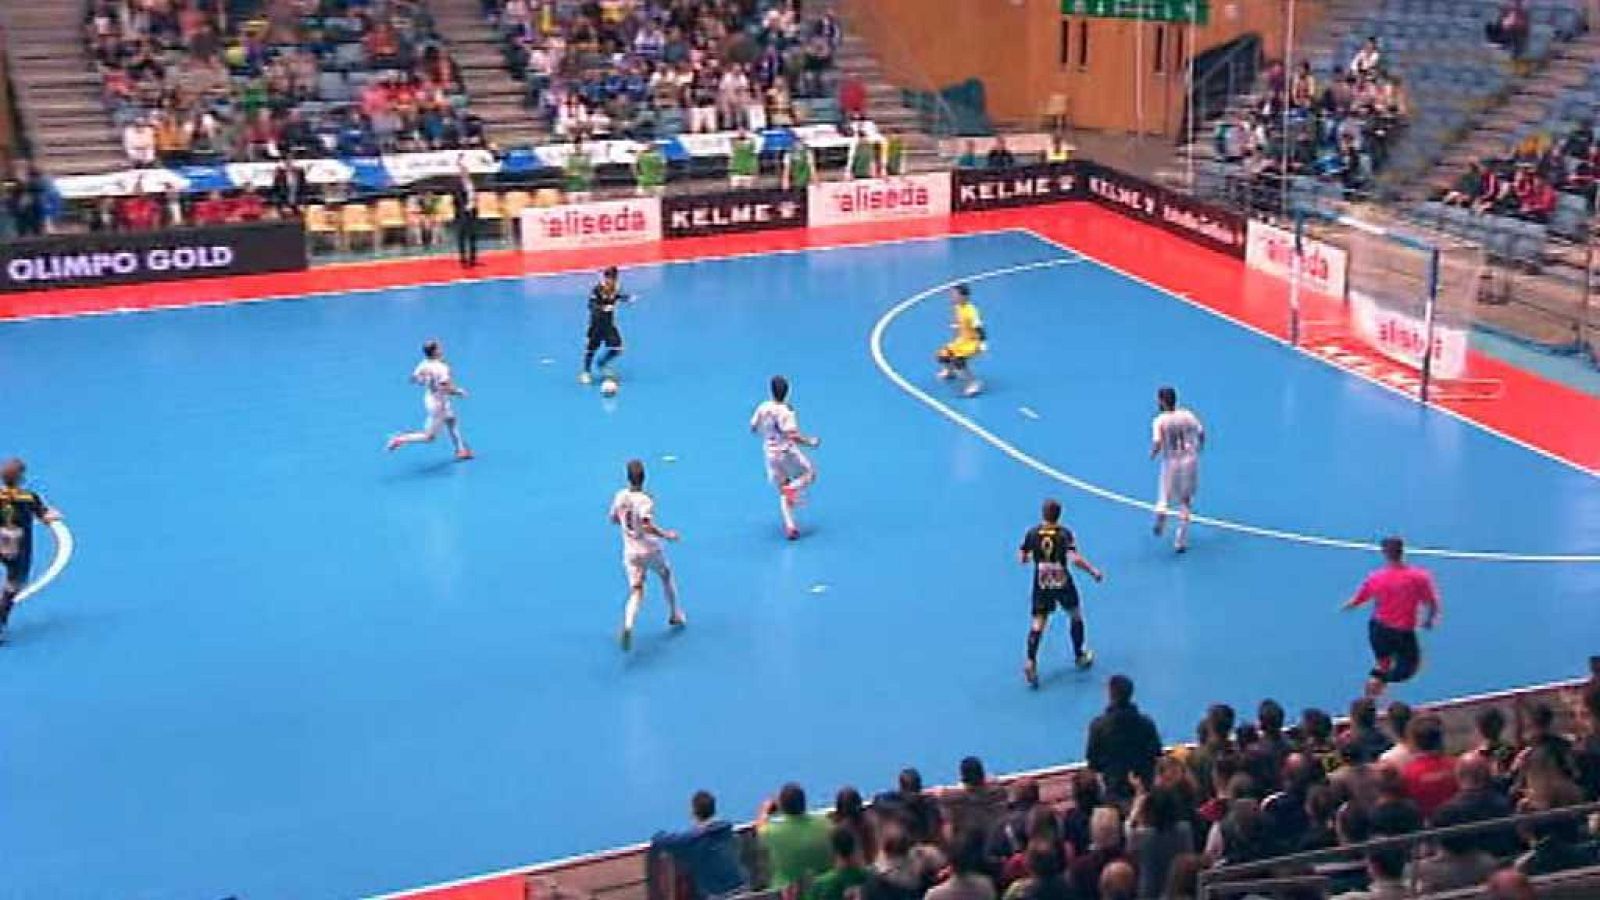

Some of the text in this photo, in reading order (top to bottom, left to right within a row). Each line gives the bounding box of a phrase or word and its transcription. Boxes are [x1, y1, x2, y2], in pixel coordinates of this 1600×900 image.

[839, 184, 929, 212] aliseda
[960, 177, 1050, 201] KELME
[548, 206, 646, 238] aliseda
[671, 203, 772, 229] KELME
[7, 246, 233, 281] OLIMPO GOLD
